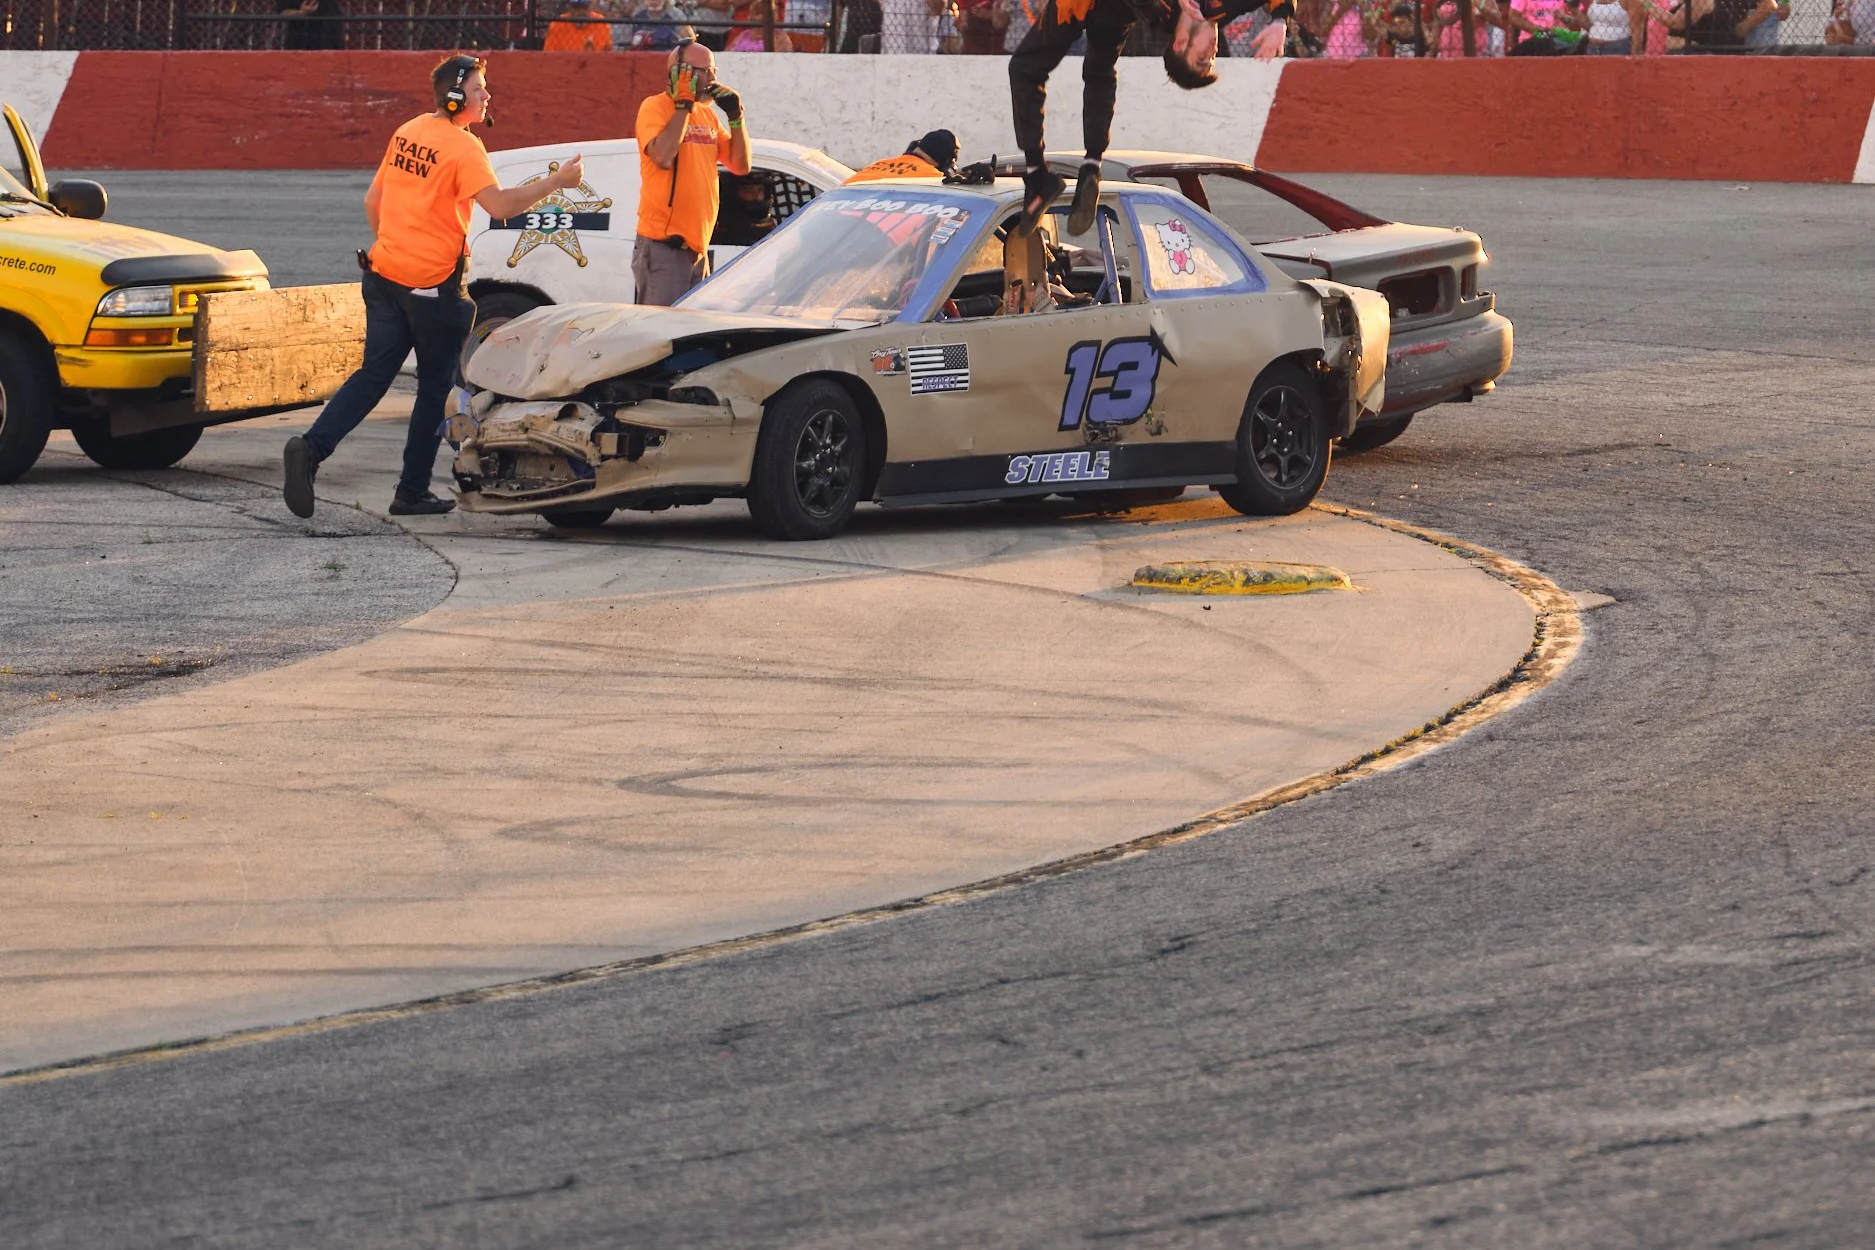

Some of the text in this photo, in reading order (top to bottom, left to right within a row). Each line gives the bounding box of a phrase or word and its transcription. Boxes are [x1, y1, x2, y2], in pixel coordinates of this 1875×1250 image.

[855, 199, 905, 211] BOO
[906, 203, 960, 218] BOO
[525, 213, 574, 229] 333
[922, 375, 958, 390] RESPECT
[1058, 335, 1163, 432] 13
[1005, 451, 1110, 483] STEELE
